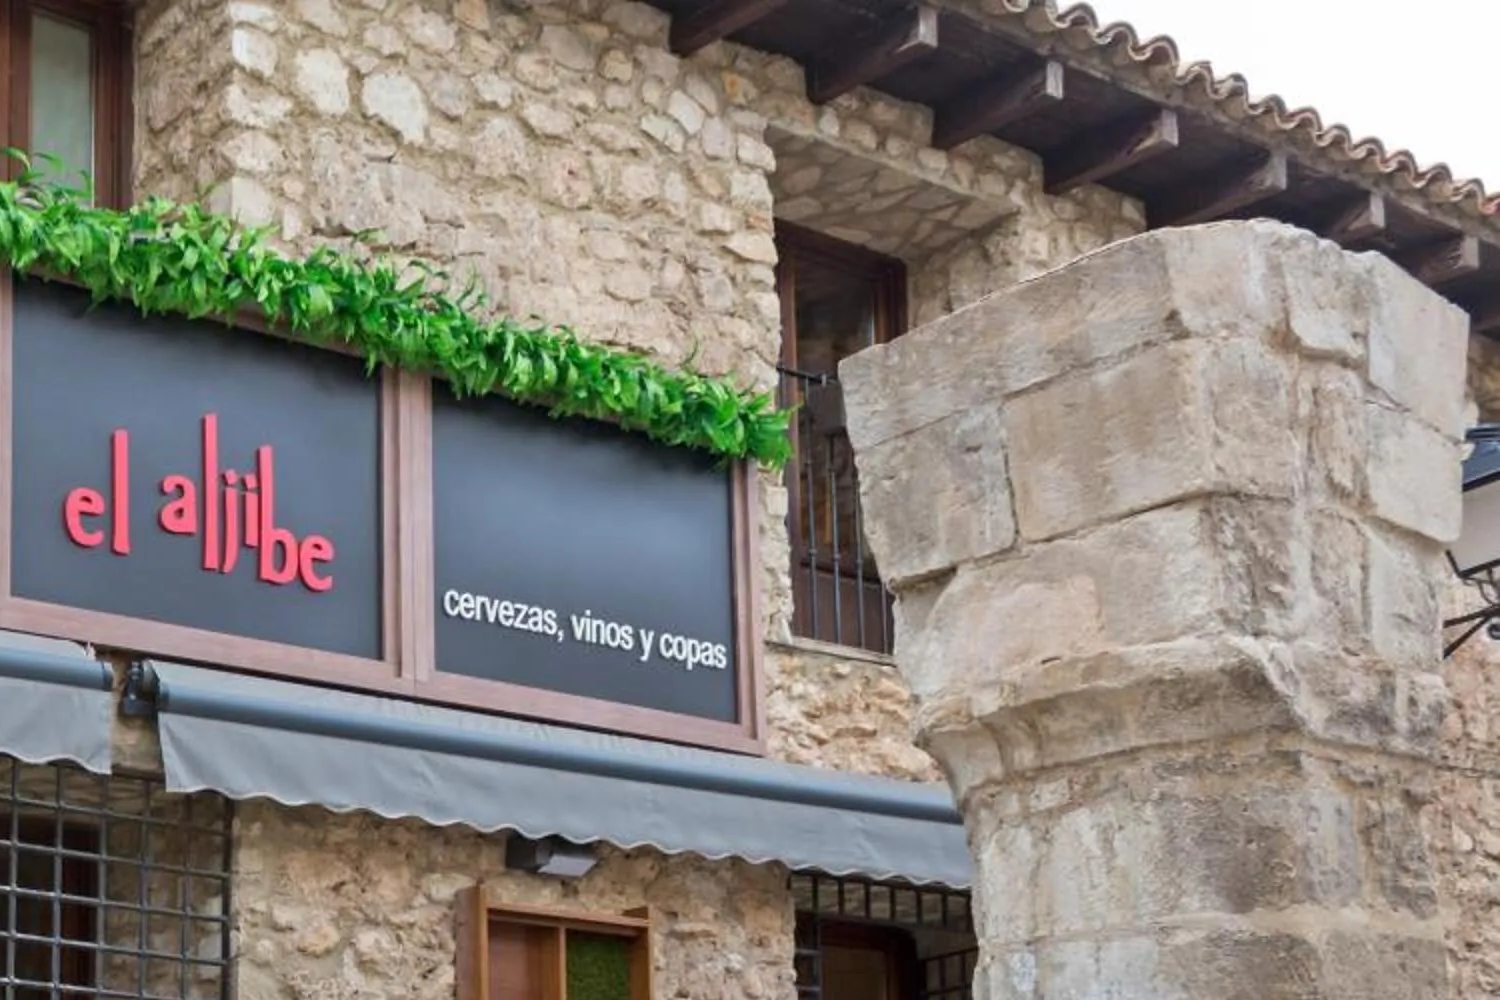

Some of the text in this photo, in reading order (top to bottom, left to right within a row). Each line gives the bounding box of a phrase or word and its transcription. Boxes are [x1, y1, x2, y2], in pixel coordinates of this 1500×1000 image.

[62, 412, 335, 592] el aljibe
[443, 588, 728, 671] cervezas, vinos y copas
